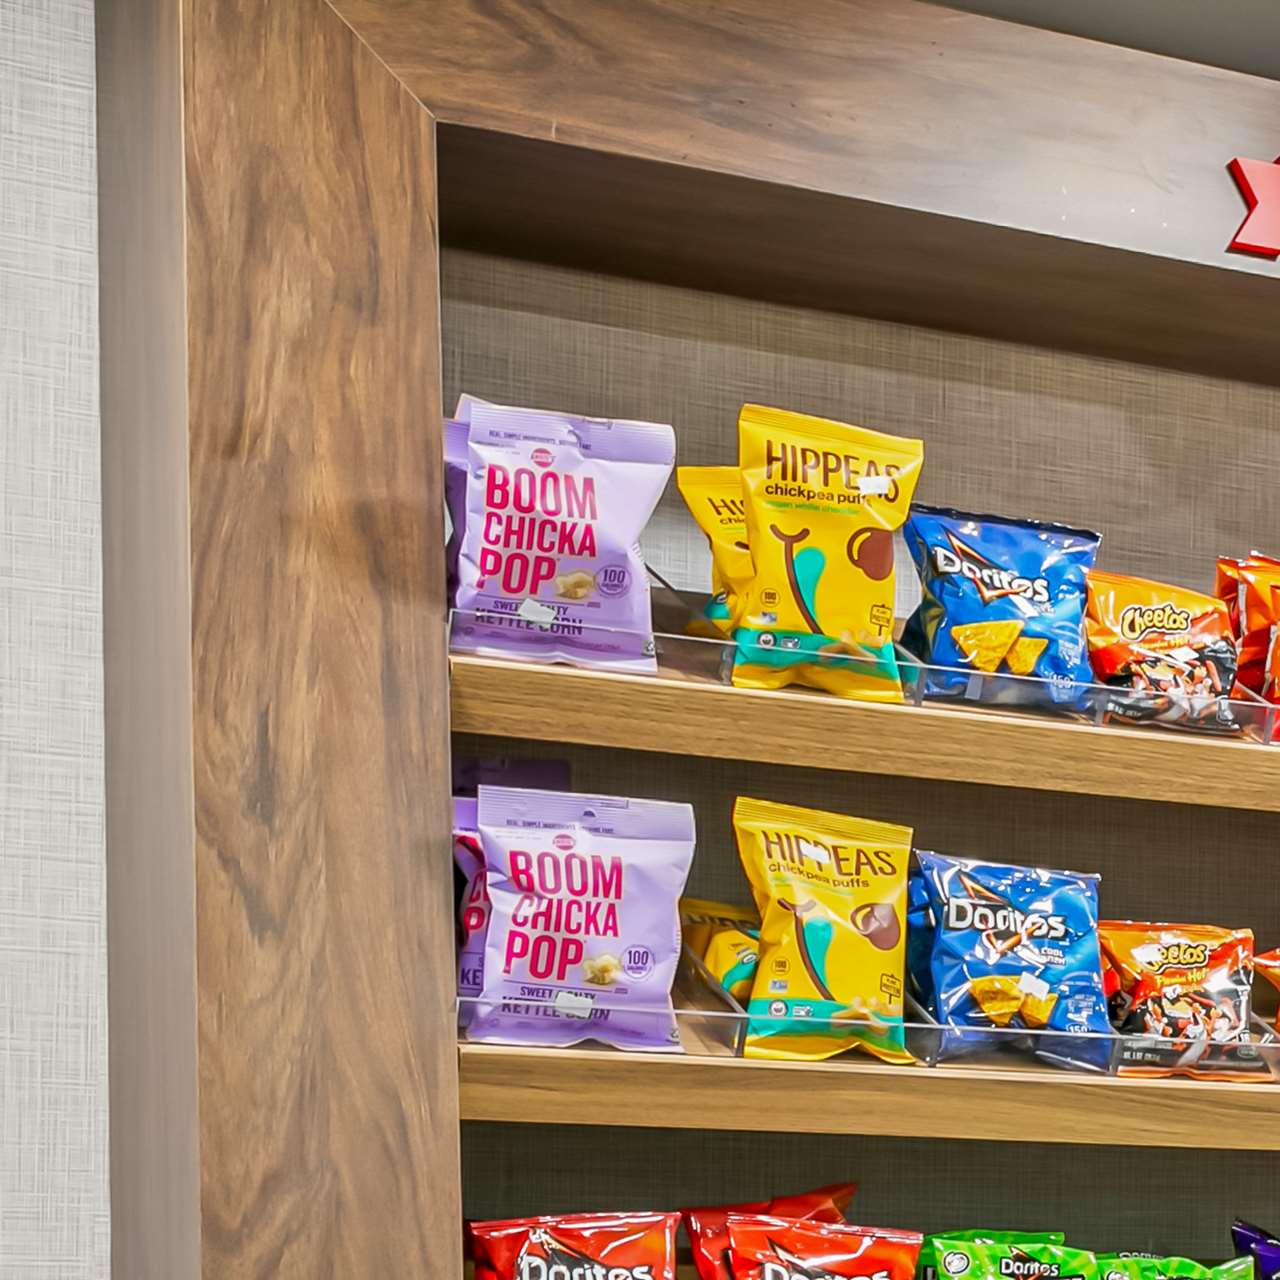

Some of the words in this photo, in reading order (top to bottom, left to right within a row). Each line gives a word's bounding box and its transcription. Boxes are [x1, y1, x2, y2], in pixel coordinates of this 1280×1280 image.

[485, 463, 598, 521] BOOM
[765, 483, 835, 502] chickpea
[837, 494, 865, 506] puf
[483, 511, 597, 558] CHICKA
[475, 547, 557, 596] POP
[602, 569, 626, 584] 100
[933, 546, 1050, 602] Doritos
[1121, 603, 1190, 641] Cheetos
[508, 849, 624, 900] BOOM
[768, 862, 830, 885] chickpea
[832, 877, 870, 889] puffs
[511, 892, 619, 938] CHICKA
[948, 897, 1067, 939] Doritos
[503, 930, 585, 981] POP
[627, 950, 650, 967] 100
[1141, 943, 1208, 973] eetos
[1001, 1257, 1060, 1277] Doritos
